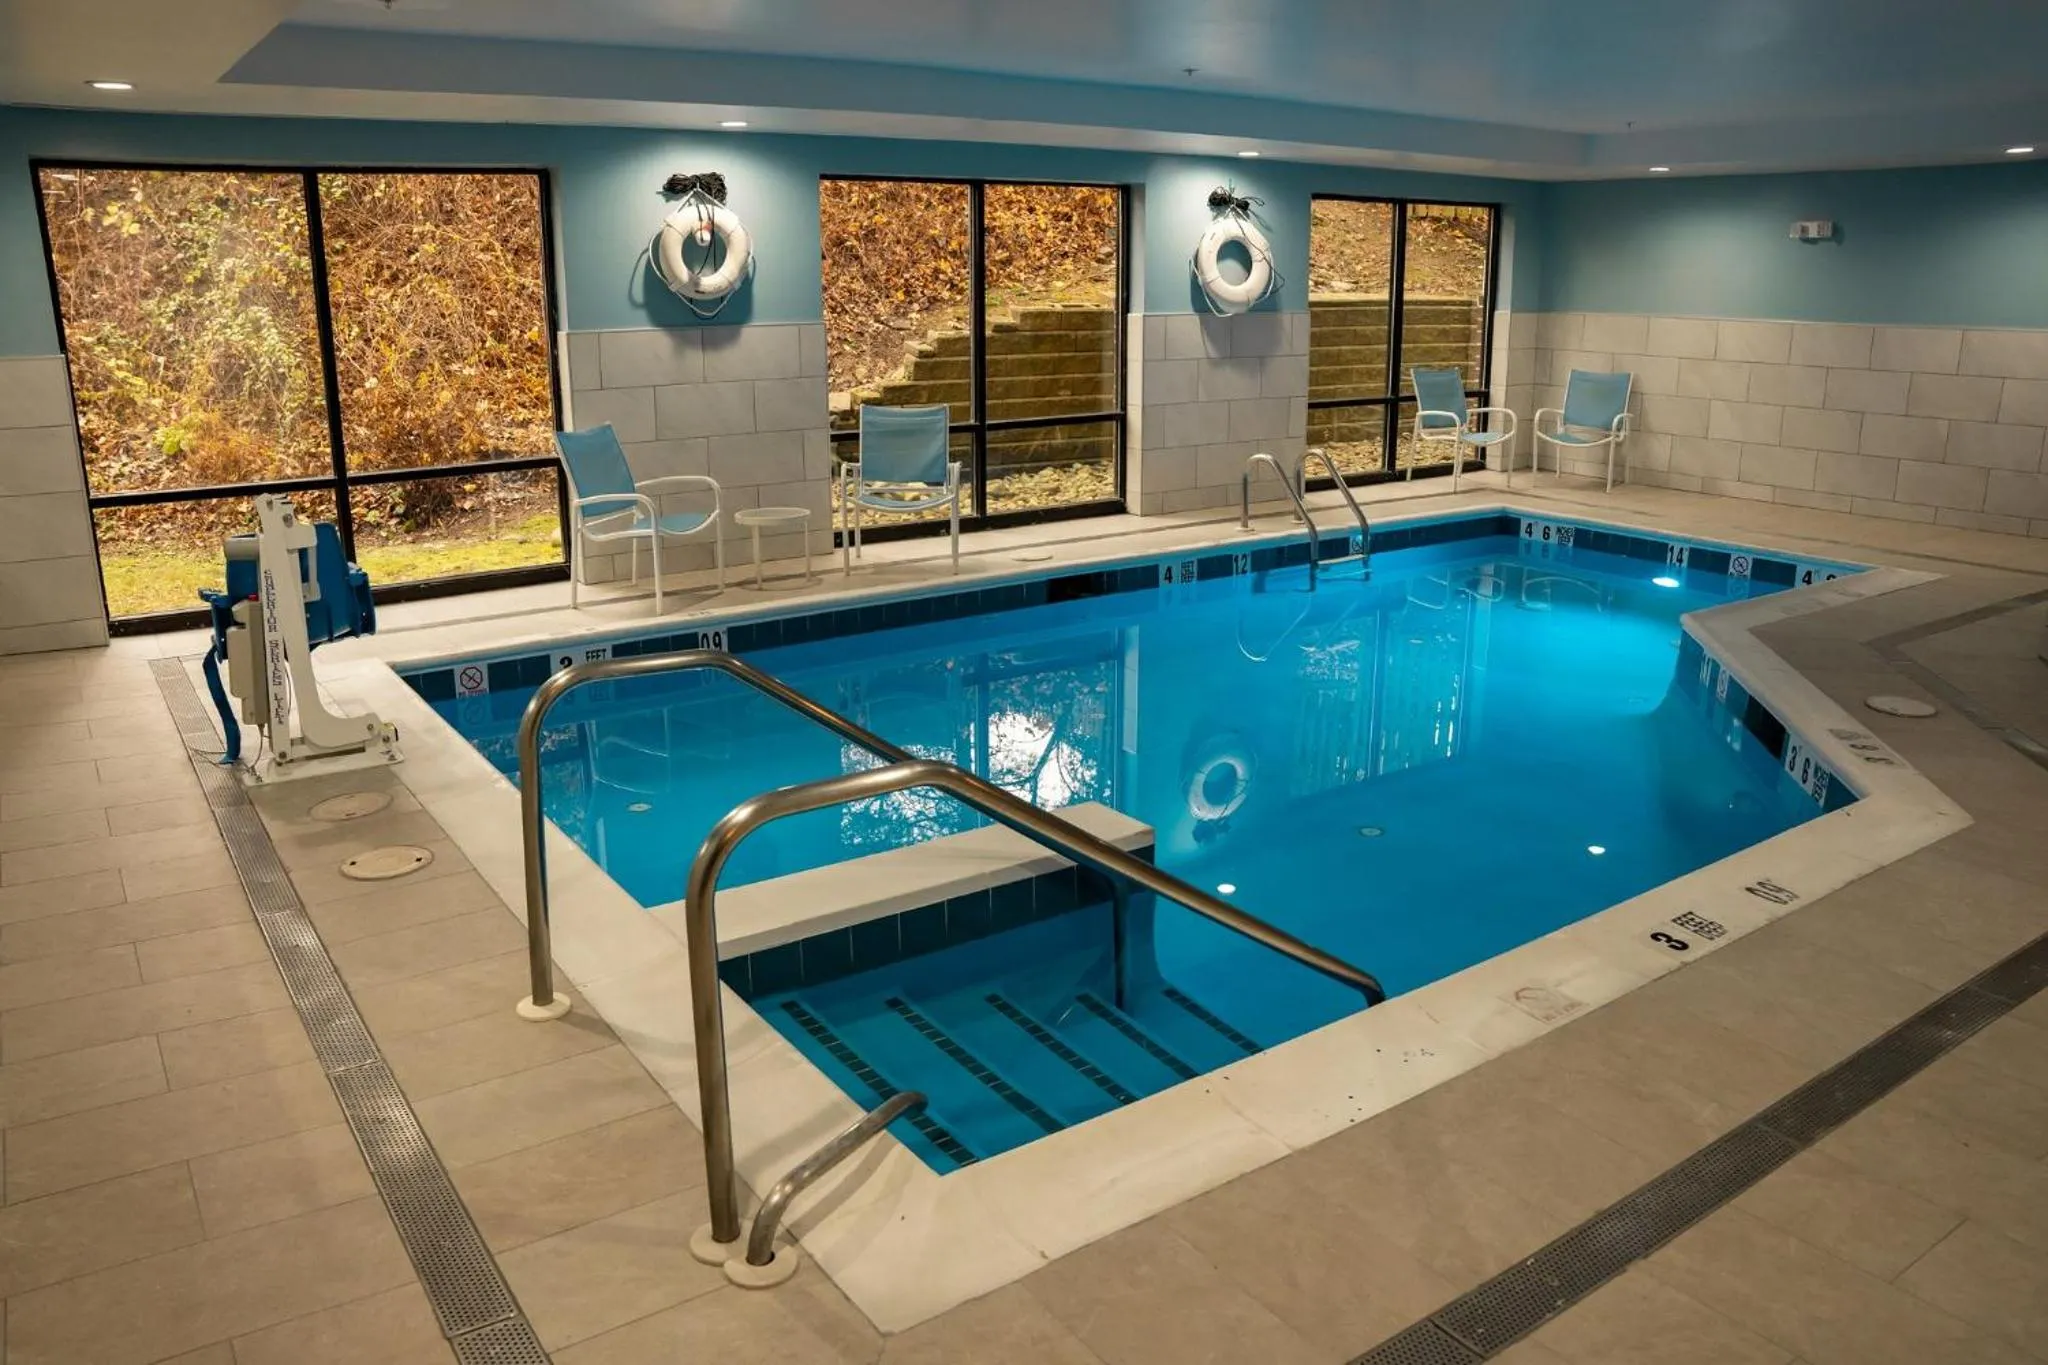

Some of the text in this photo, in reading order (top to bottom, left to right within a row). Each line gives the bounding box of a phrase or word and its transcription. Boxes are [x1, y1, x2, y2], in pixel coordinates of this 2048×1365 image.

[1525, 522, 1533, 538] 4
[1543, 525, 1551, 541] 6
[1163, 565, 1173, 584] 4
[1802, 570, 1812, 585] 4
[1790, 745, 1798, 772] 3
[1802, 757, 1811, 785] 6
[1650, 931, 1690, 951] 3
